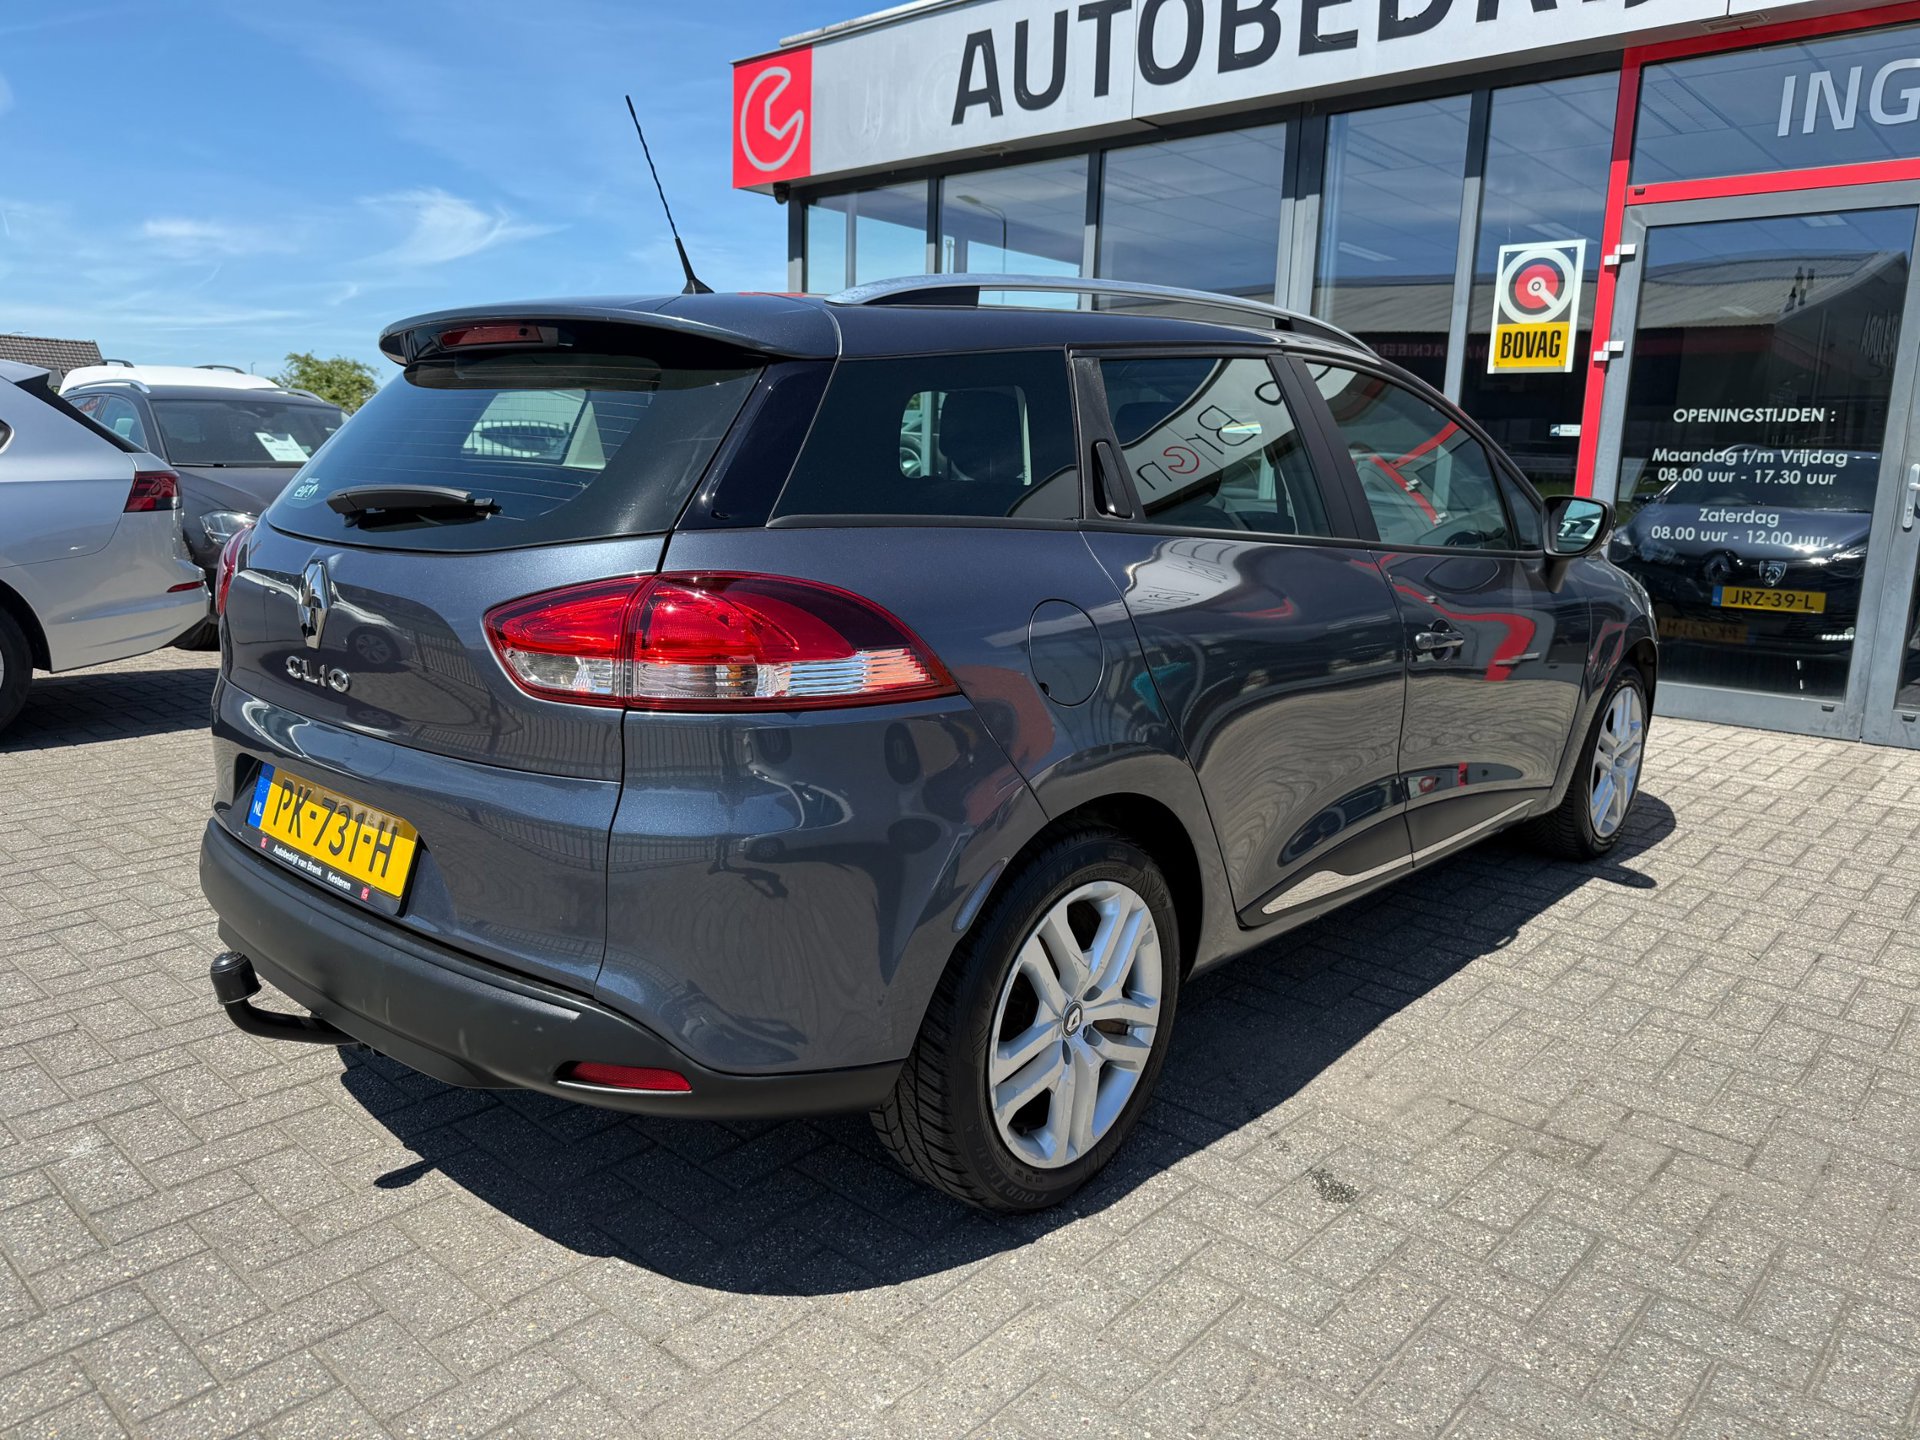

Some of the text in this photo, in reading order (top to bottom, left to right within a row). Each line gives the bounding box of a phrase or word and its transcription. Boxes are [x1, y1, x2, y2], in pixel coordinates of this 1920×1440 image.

[1777, 58, 1920, 136] ING
[1500, 330, 1562, 359] BOVAG
[1673, 407, 1825, 423] OPENINGSTIJDEN
[1652, 448, 1848, 468] Maandag t/m Vrijdag
[1657, 467, 1702, 482] 08.00
[1707, 471, 1736, 483] uur
[1754, 469, 1801, 485] 17.30
[1806, 472, 1837, 485] uur
[1699, 508, 1780, 528] Zaterdag
[1651, 525, 1696, 540] 08.00
[1700, 530, 1728, 542] uur
[1747, 530, 1793, 546] 12.00
[1798, 534, 1829, 547] uur
[1730, 589, 1815, 610] JRZ-39-L
[286, 655, 350, 693] CLIO
[252, 801, 262, 817] NL
[273, 777, 398, 878] PK-731-H
[273, 844, 352, 891] Autobedrijf van Brenk Kesteren
